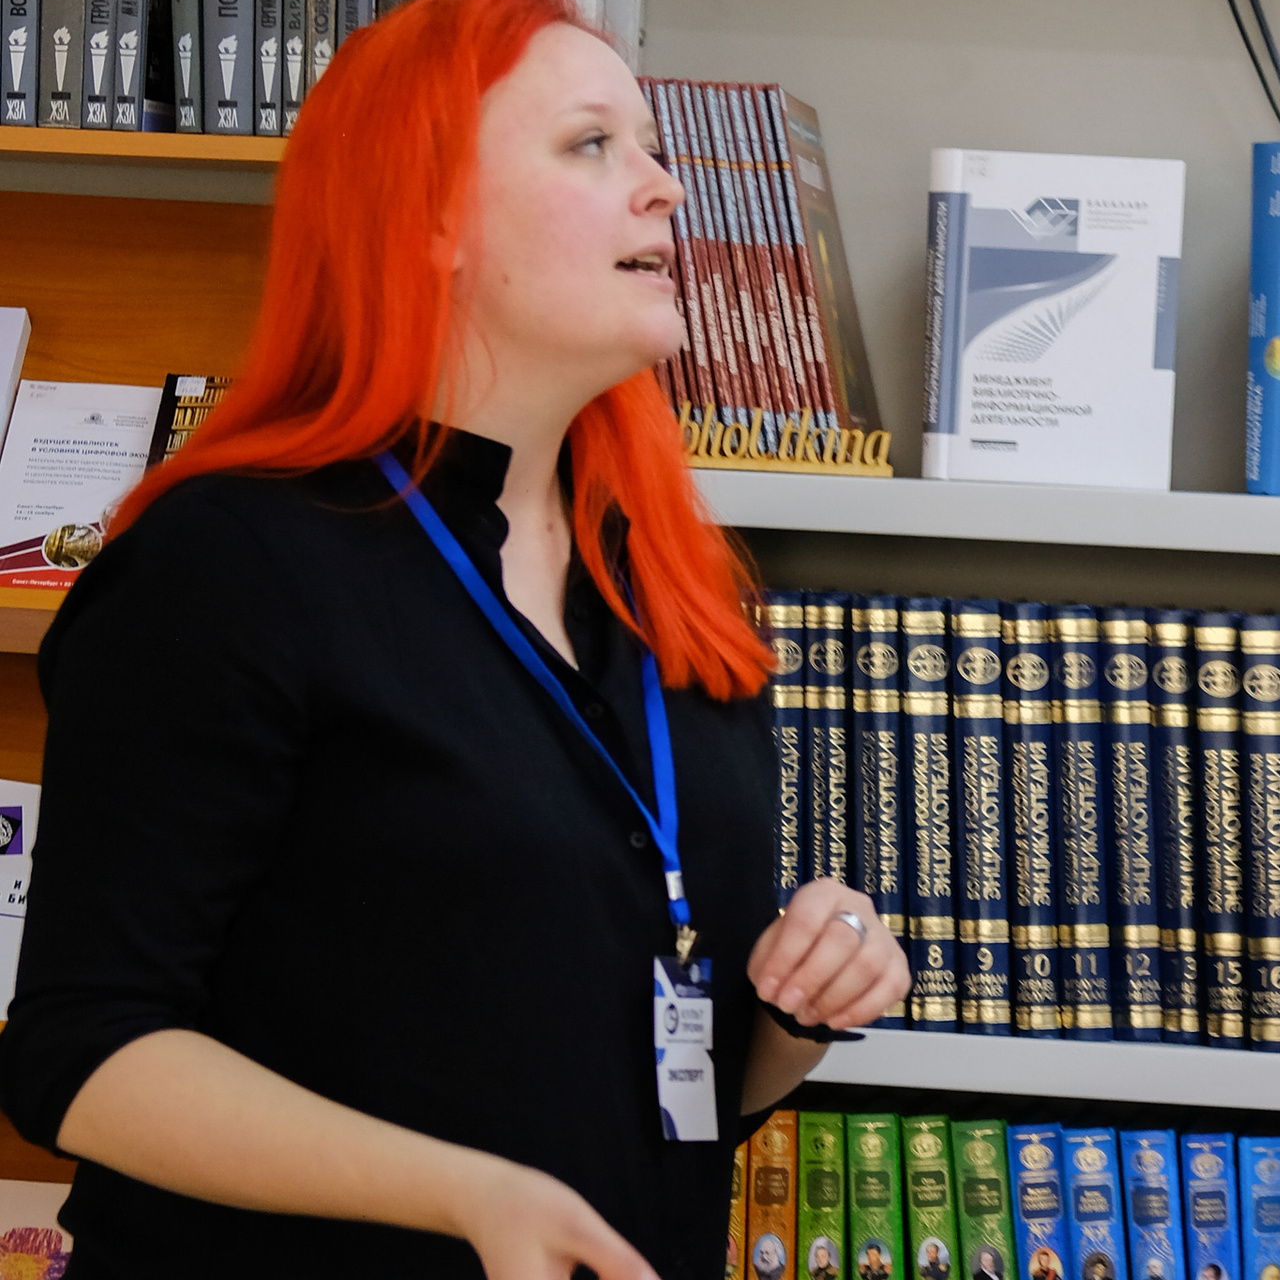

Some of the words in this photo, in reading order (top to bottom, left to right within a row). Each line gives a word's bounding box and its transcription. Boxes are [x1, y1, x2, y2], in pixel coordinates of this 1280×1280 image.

[6, 100, 27, 121] ЖЗЛ
[50, 101, 70, 121] ЖЗЛ
[87, 103, 107, 123] ЖЗЛ
[116, 103, 136, 124] ЖЗЛ
[180, 106, 195, 126] ЖЗЛ
[218, 108, 238, 128] ЖЗЛ
[259, 109, 277, 130] ЖЗЛ
[780, 725, 800, 890] ЭНЦИКЛОПЕДИЯ
[930, 733, 951, 897] ЭНЦИКЛОПЕДИЯ
[980, 735, 1001, 900] ЭНЦИКЛОПЕДИЯ
[1129, 742, 1151, 905] ЭНЦИКЛОПЕДИЯ
[1221, 748, 1241, 913] ЭНЦИКЛОПЕДИЯ
[926, 944, 944, 969] 8
[976, 946, 994, 971] 9
[1022, 952, 1051, 977] 10
[1072, 952, 1097, 976] 11
[1125, 952, 1151, 977] 12
[1214, 960, 1243, 985] 15
